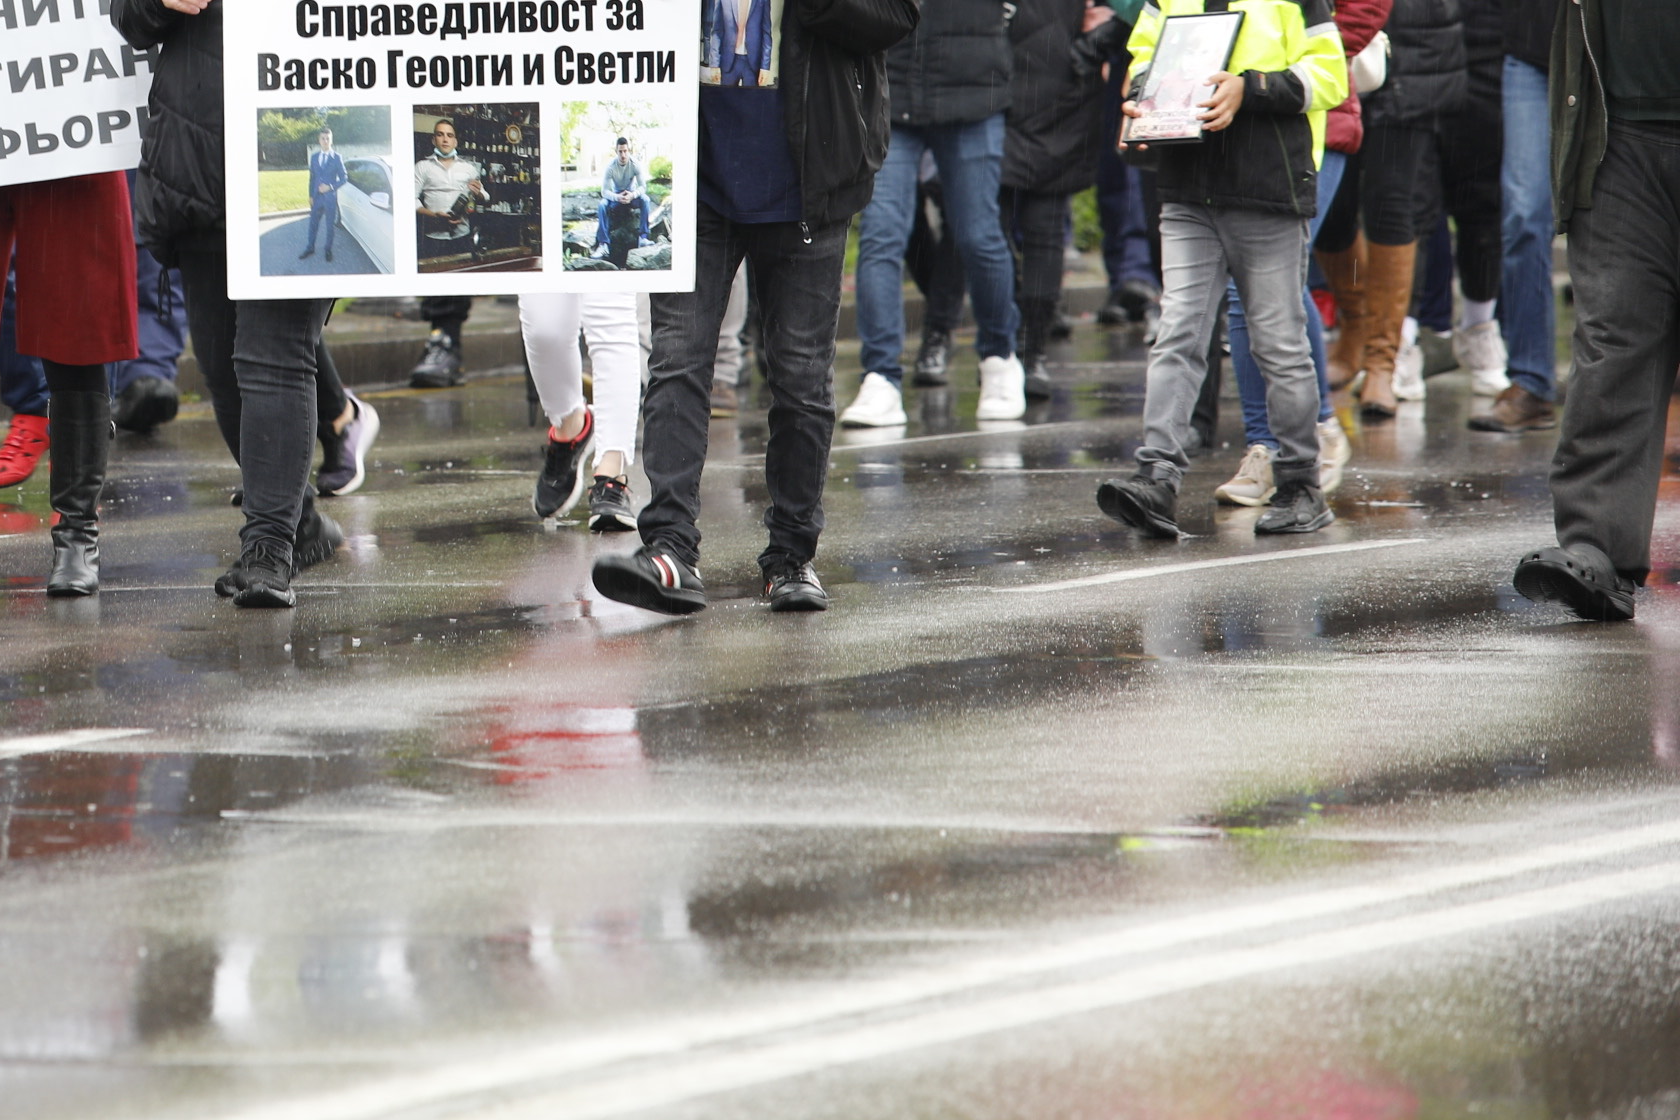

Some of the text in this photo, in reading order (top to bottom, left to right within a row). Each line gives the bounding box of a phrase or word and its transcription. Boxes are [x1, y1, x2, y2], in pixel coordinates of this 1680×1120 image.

[258, 44, 676, 92] Васко Георги и Светли
